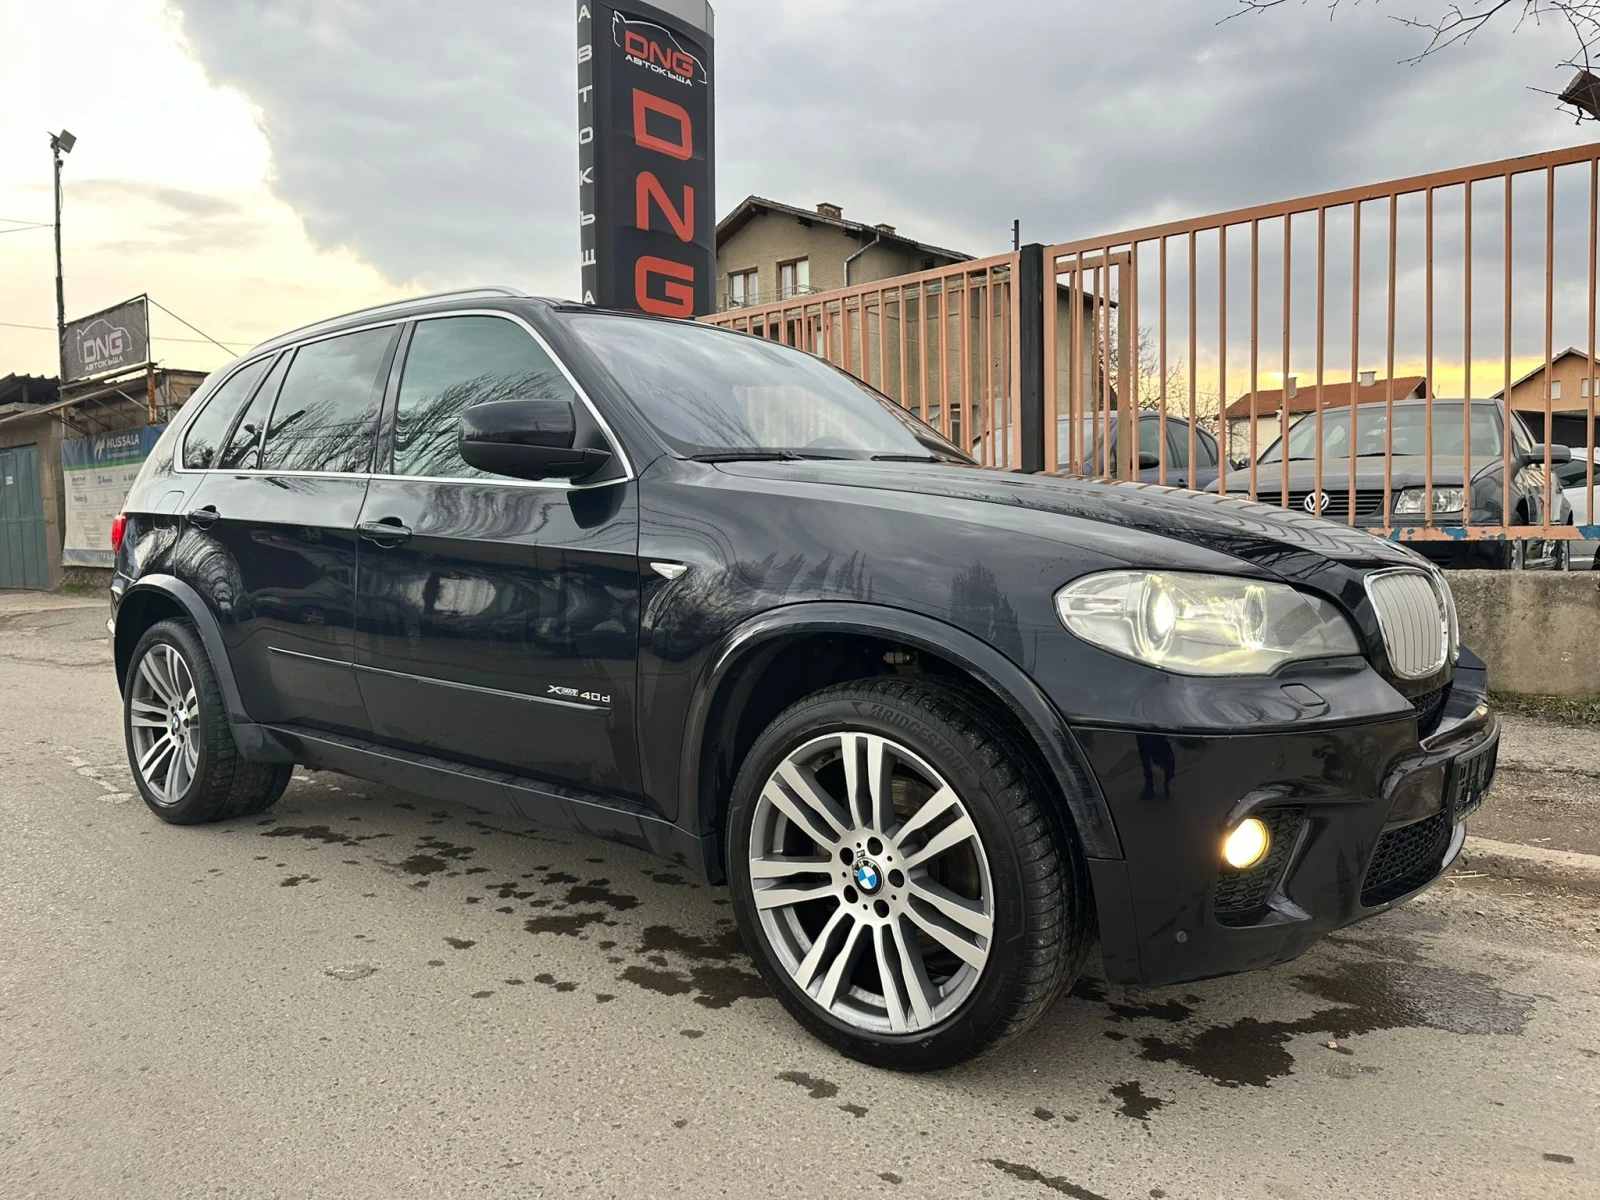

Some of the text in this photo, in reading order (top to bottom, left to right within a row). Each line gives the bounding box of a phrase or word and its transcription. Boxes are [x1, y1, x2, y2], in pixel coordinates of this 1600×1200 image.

[624, 30, 694, 78] DNG
[632, 87, 695, 318] DNG
[83, 330, 123, 363] DNG
[107, 433, 140, 448] MUSSALA
[580, 691, 611, 703] 40d
[870, 704, 973, 777] BRIDGESTONE
